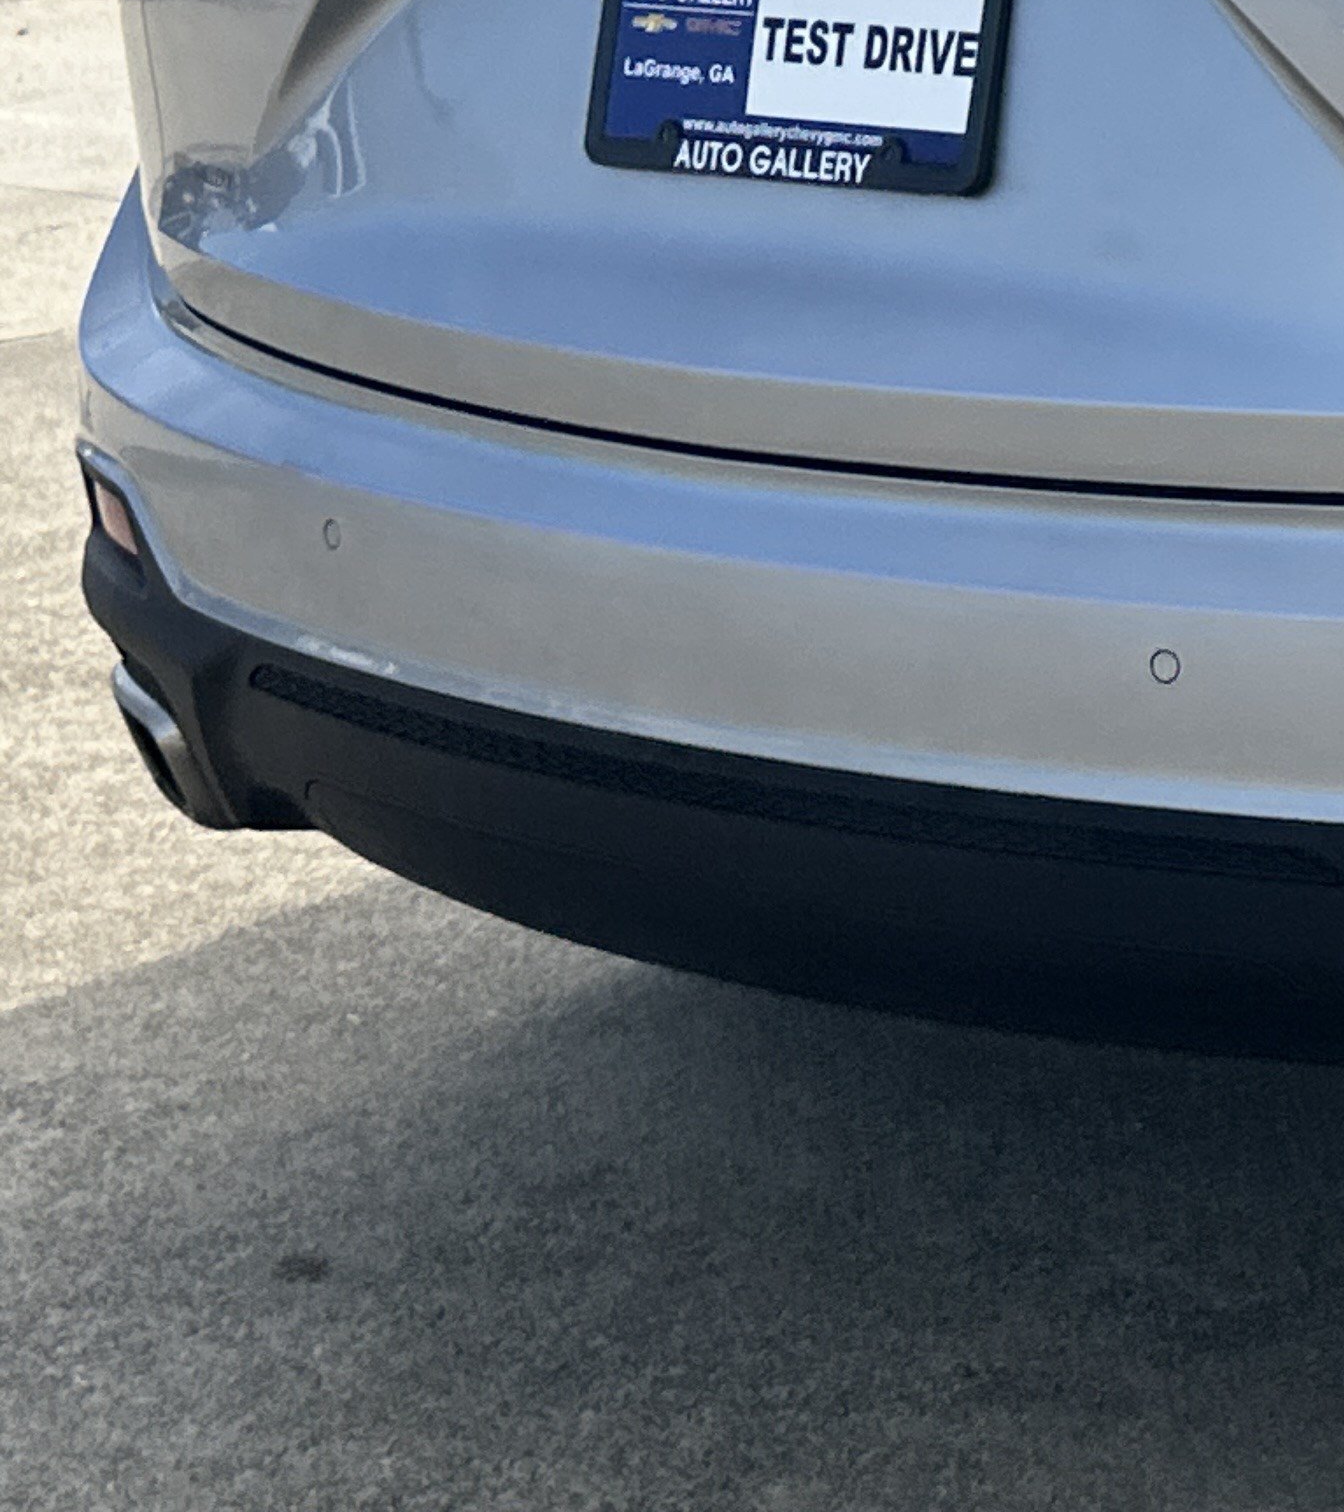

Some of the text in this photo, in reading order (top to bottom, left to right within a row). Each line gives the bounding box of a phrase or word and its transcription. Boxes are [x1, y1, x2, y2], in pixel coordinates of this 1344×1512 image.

[763, 17, 980, 76] TEST DRIVE
[623, 56, 735, 85] LaGrange, GA
[673, 139, 871, 183] AUTO GALLERY
